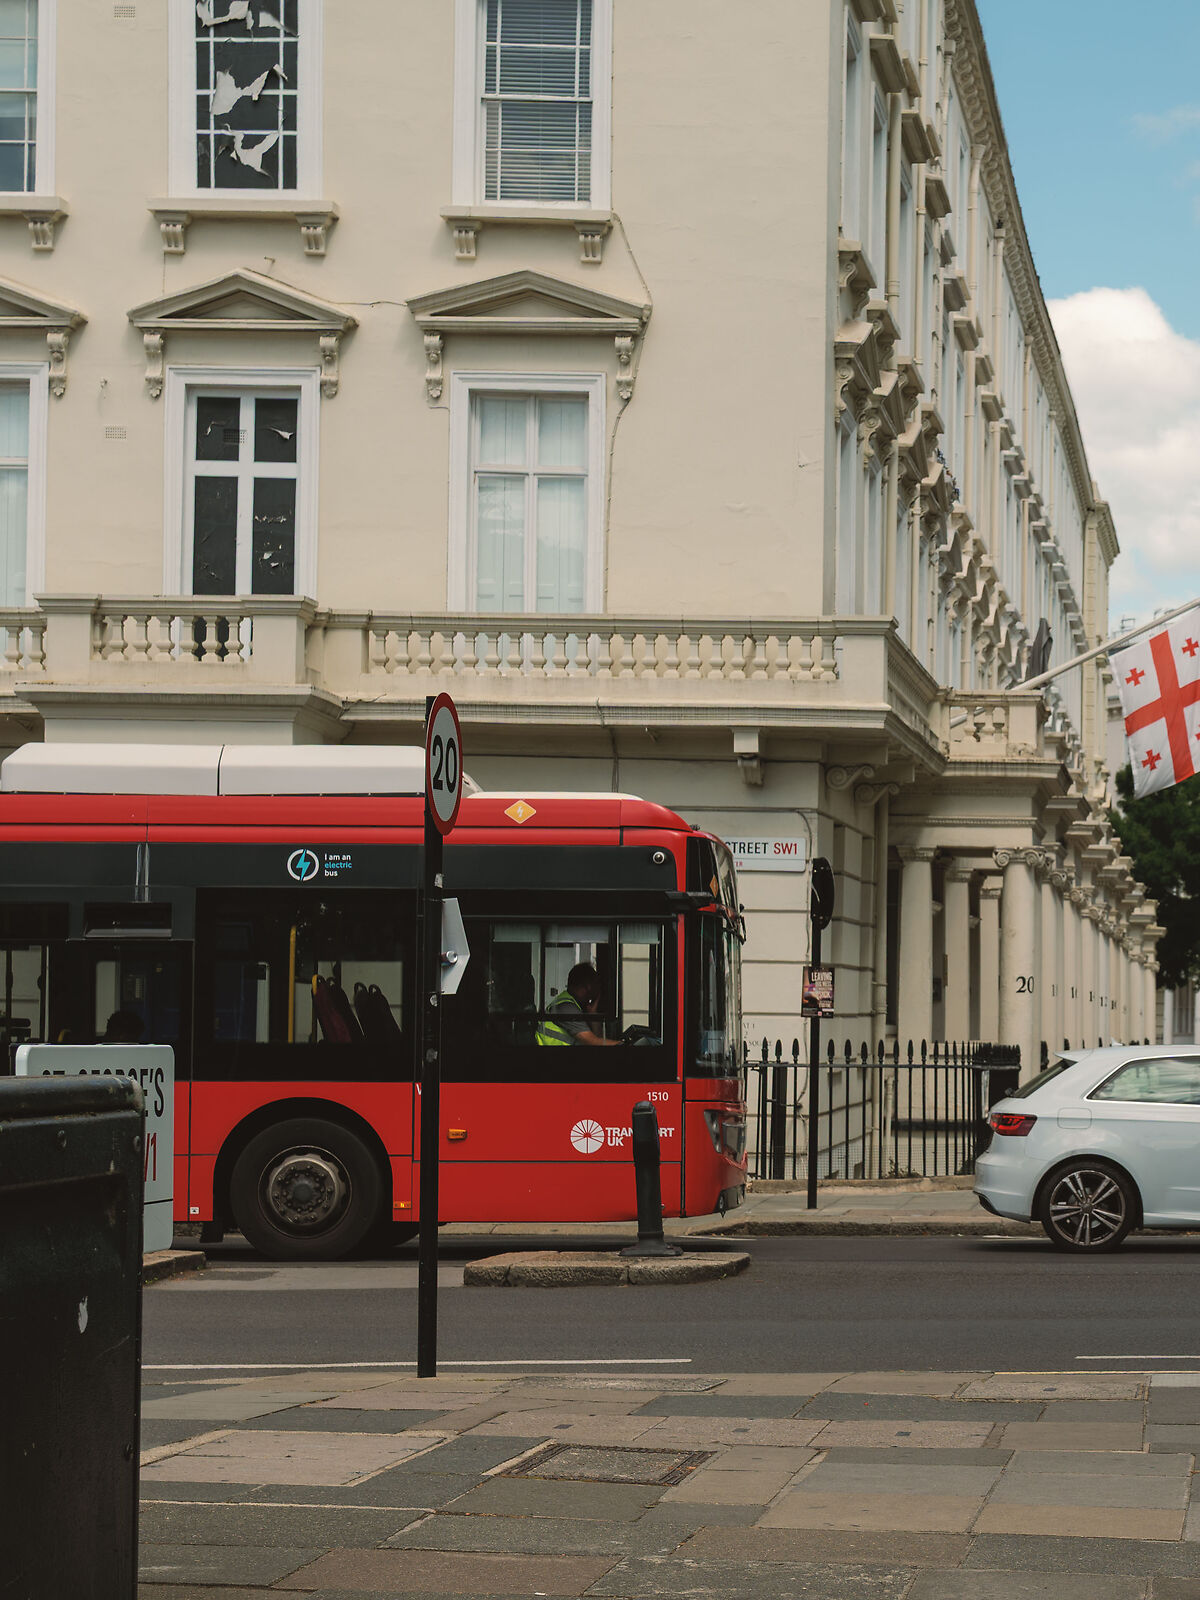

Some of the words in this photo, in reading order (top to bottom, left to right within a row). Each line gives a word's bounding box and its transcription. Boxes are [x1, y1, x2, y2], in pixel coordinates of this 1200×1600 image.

[432, 734, 458, 794] 20
[773, 842, 798, 855] SW1
[324, 869, 338, 877] bus
[1015, 976, 1035, 994] 20
[647, 1091, 669, 1101] 1510
[605, 1126, 675, 1138] TRANRT
[607, 1136, 624, 1147] UK
